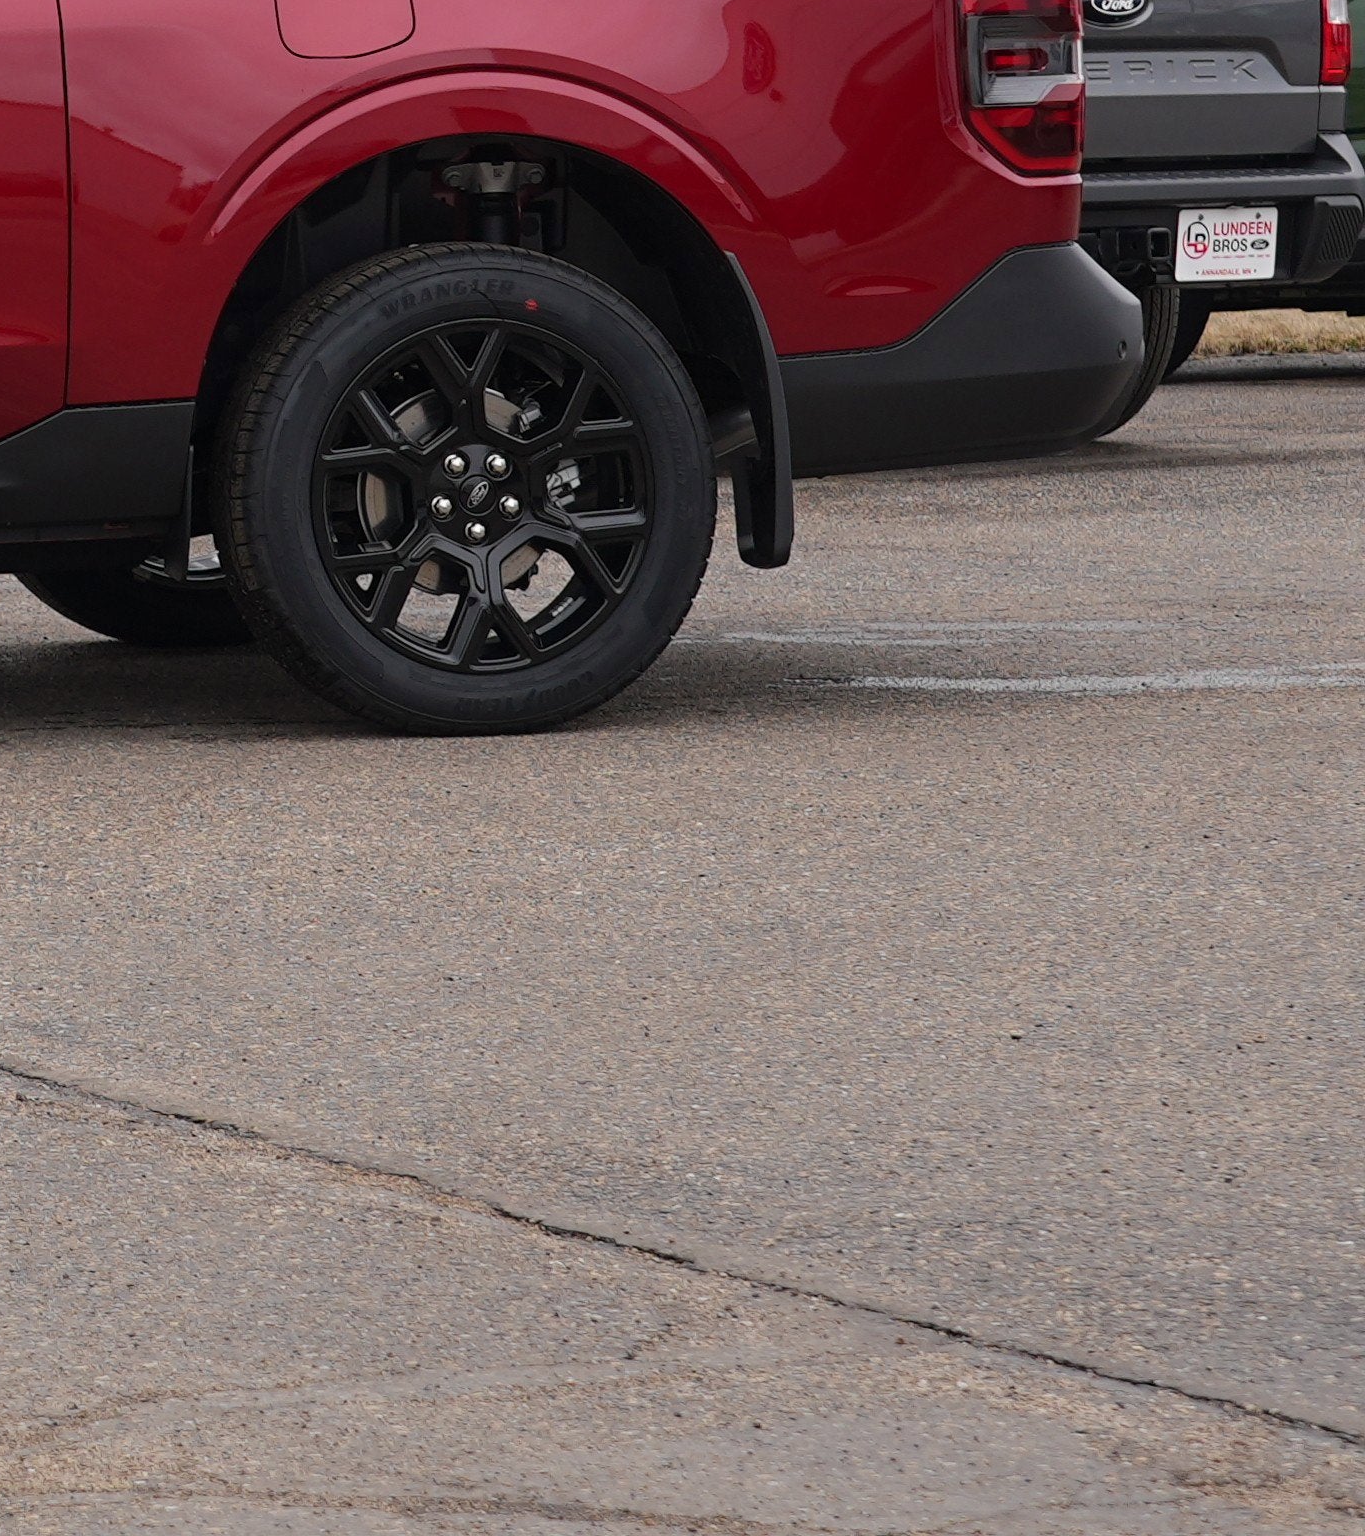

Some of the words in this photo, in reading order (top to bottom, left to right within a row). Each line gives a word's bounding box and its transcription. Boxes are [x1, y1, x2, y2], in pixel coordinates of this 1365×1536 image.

[1084, 58, 1258, 84] ERICK
[1213, 220, 1273, 236] LUNDEEN
[1212, 238, 1248, 253] BROS
[379, 278, 516, 321] WRANGLER
